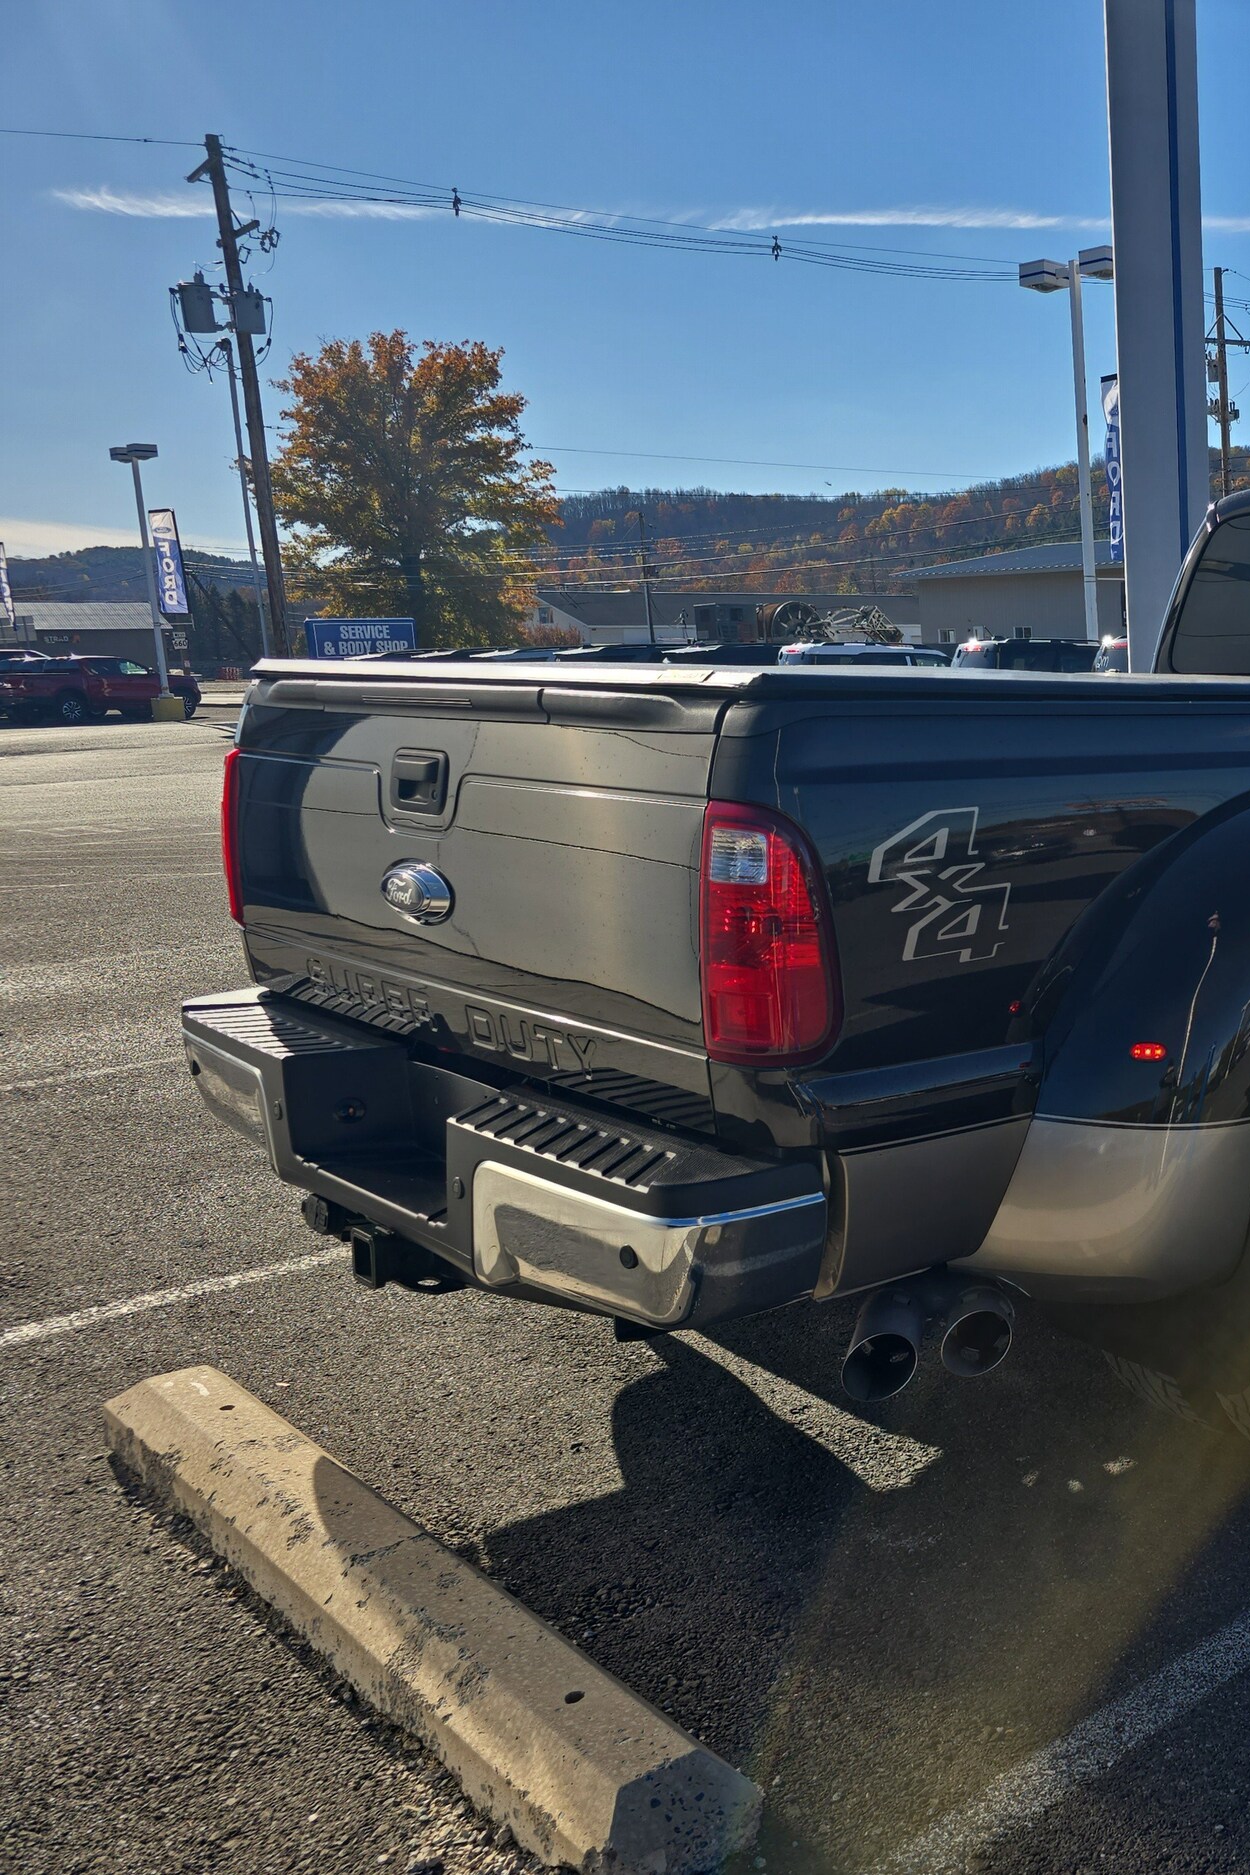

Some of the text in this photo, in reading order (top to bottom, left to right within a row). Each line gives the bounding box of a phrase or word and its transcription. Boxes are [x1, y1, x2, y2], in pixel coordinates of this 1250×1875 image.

[340, 625, 391, 640] SERVICE
[174, 639, 187, 647] 660
[323, 640, 409, 656] & BODY SHOP
[386, 878, 413, 905] Ford
[305, 957, 598, 1081] SUPER DUTY
